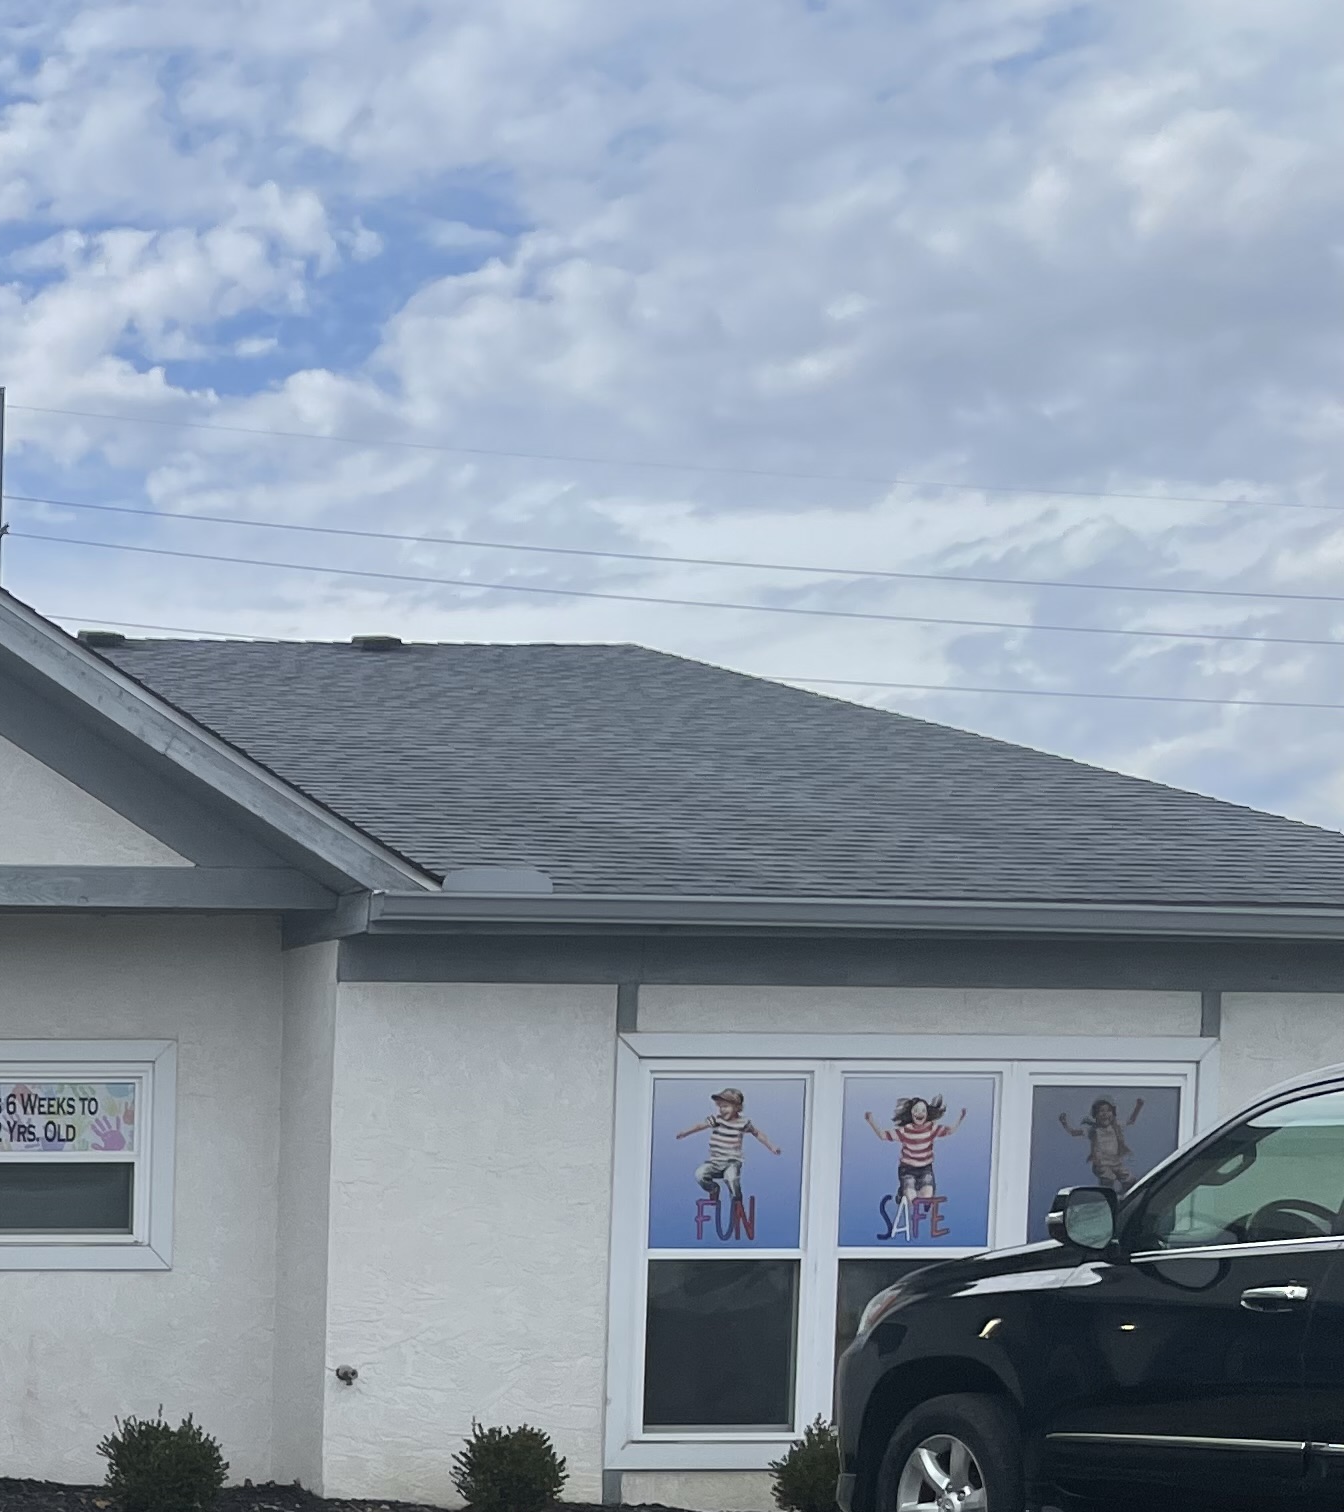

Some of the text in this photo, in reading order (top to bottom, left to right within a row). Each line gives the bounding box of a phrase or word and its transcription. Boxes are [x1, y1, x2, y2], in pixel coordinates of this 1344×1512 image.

[6, 1093, 17, 1116] 6
[694, 1195, 756, 1242] FUN
[876, 1195, 951, 1242] SAFE
